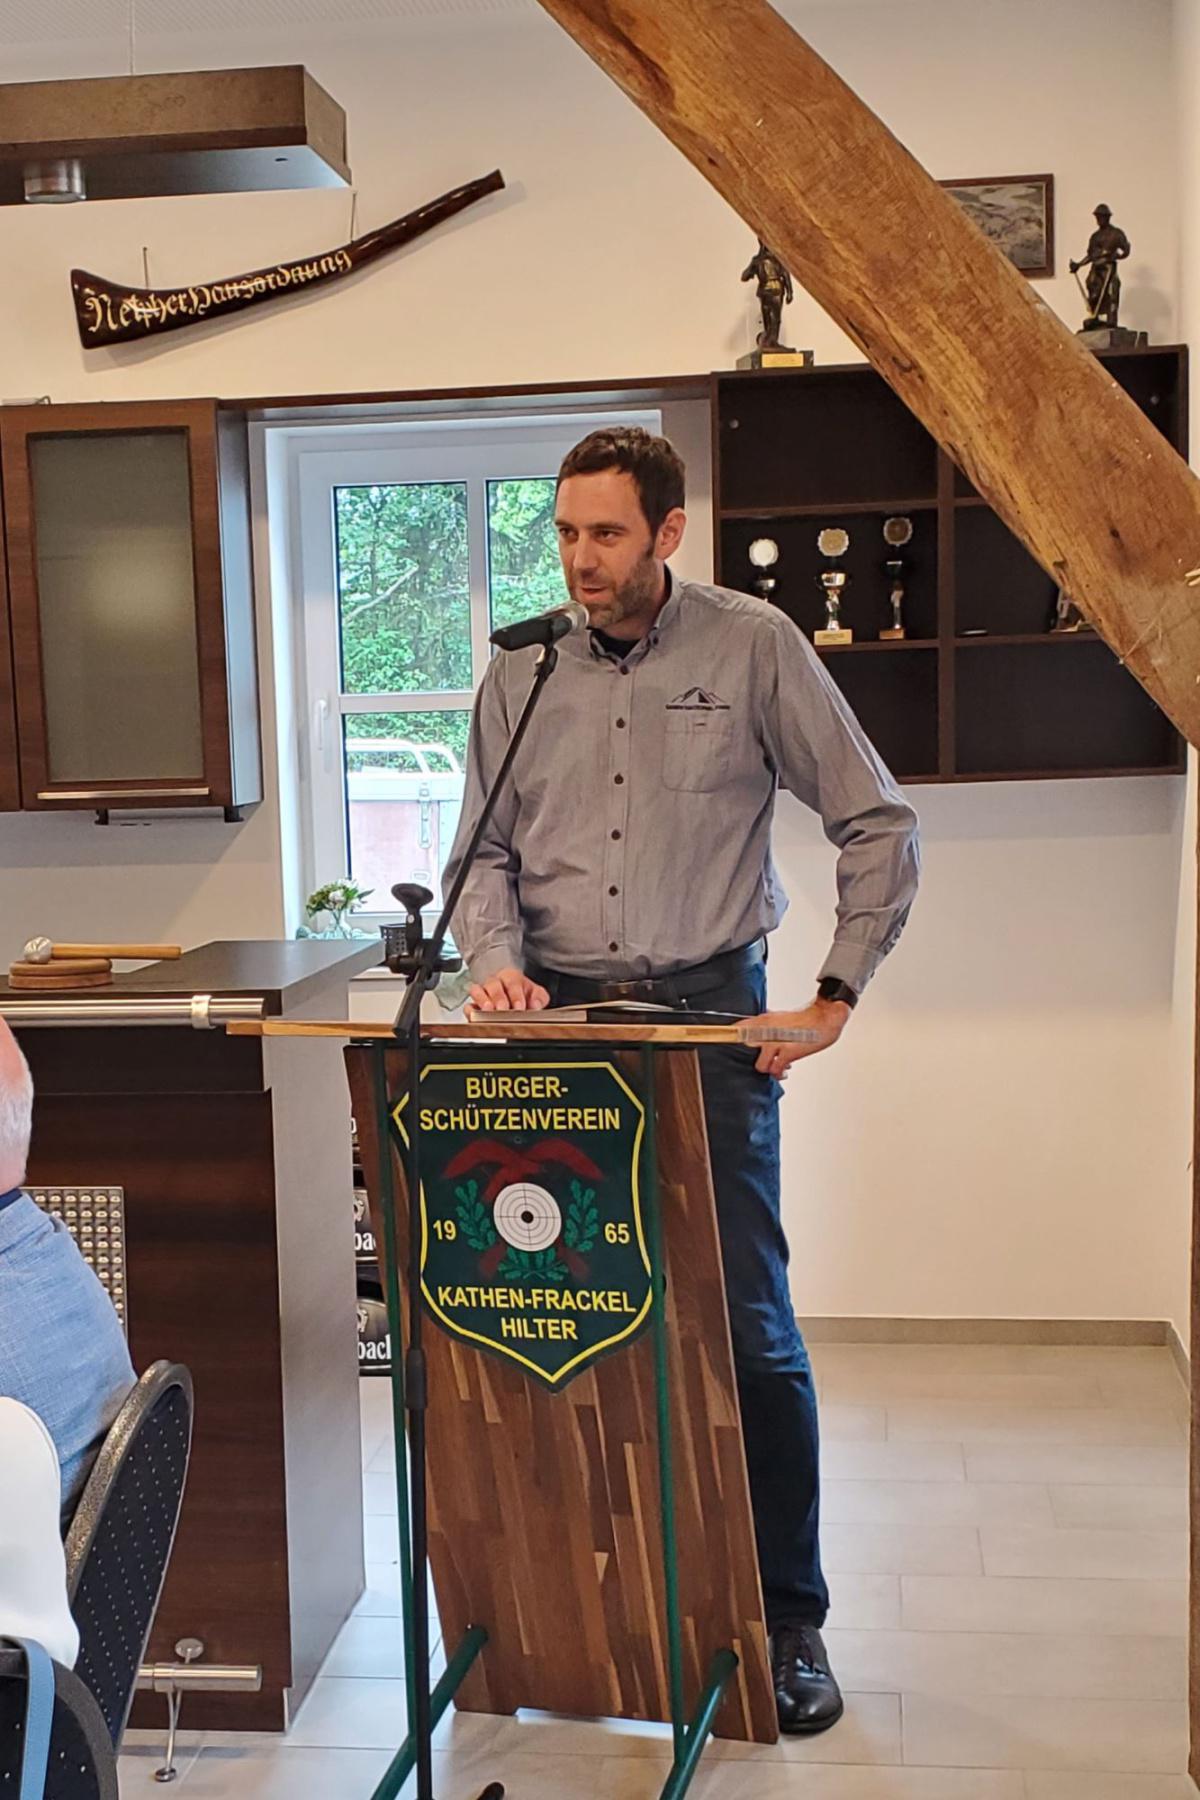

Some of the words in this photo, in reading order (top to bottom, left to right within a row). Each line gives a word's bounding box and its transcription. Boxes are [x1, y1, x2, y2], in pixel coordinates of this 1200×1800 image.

[466, 1072, 569, 1099] BÜRGER-
[419, 1104, 620, 1131] SCHÜTZENVEREIN
[433, 1220, 457, 1240] 19
[604, 1223, 630, 1244] 65
[437, 1286, 637, 1313] KATHEN-FRACKEL
[501, 1318, 578, 1340] HILTER
